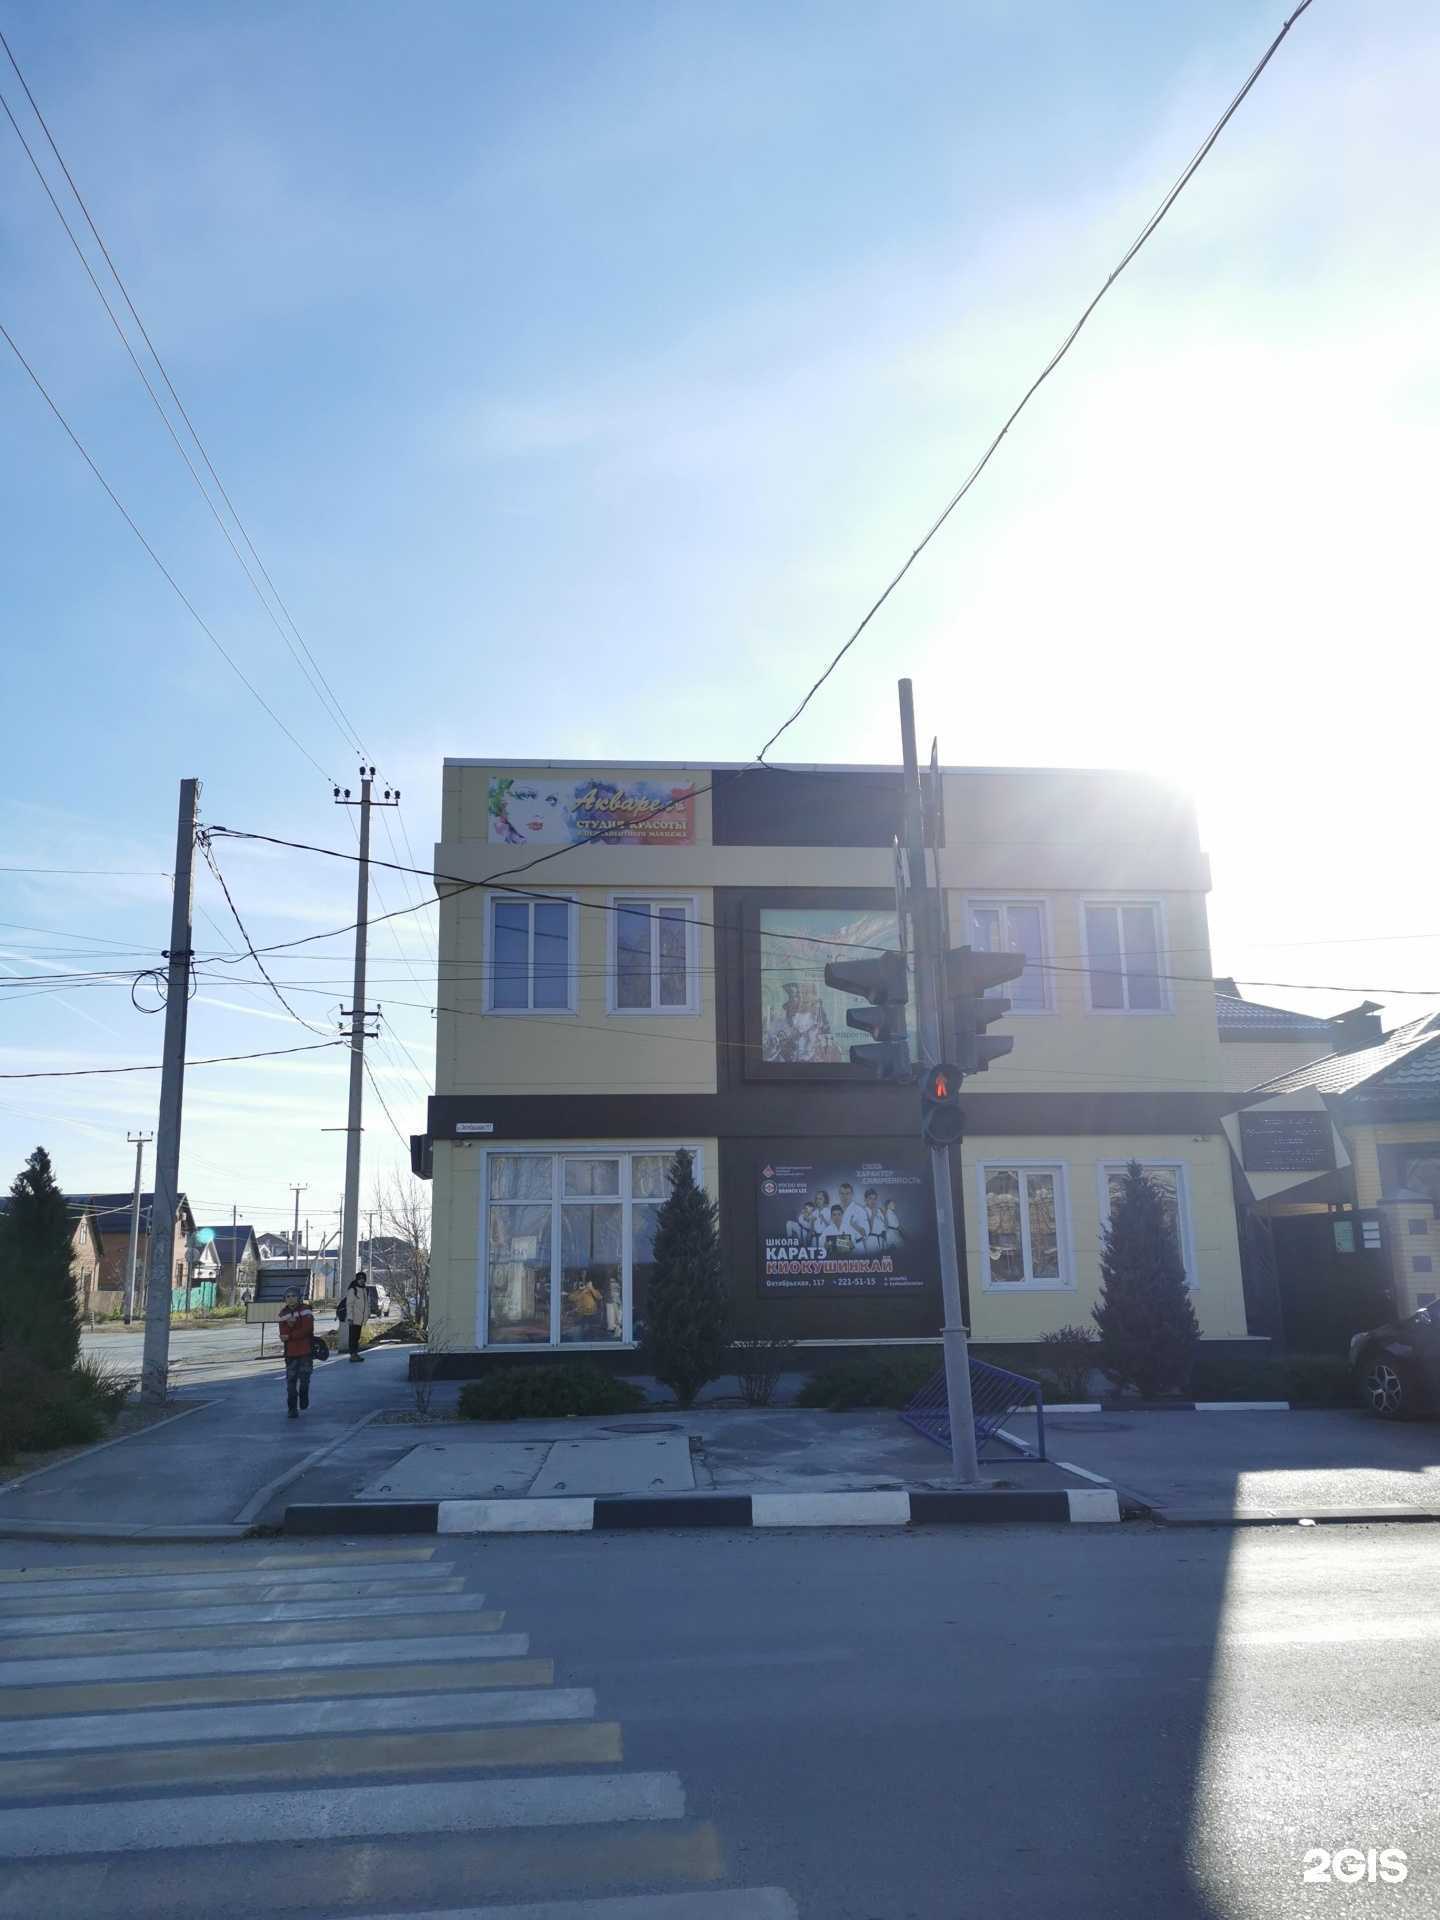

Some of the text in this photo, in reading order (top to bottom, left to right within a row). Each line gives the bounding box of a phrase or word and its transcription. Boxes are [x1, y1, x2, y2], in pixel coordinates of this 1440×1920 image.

[765, 1237, 799, 1247] школа
[765, 1247, 827, 1260] КАРАТЭ
[765, 1256, 893, 1275] КИОКУШИНКАЙ
[838, 1277, 877, 1286] 221-51-15
